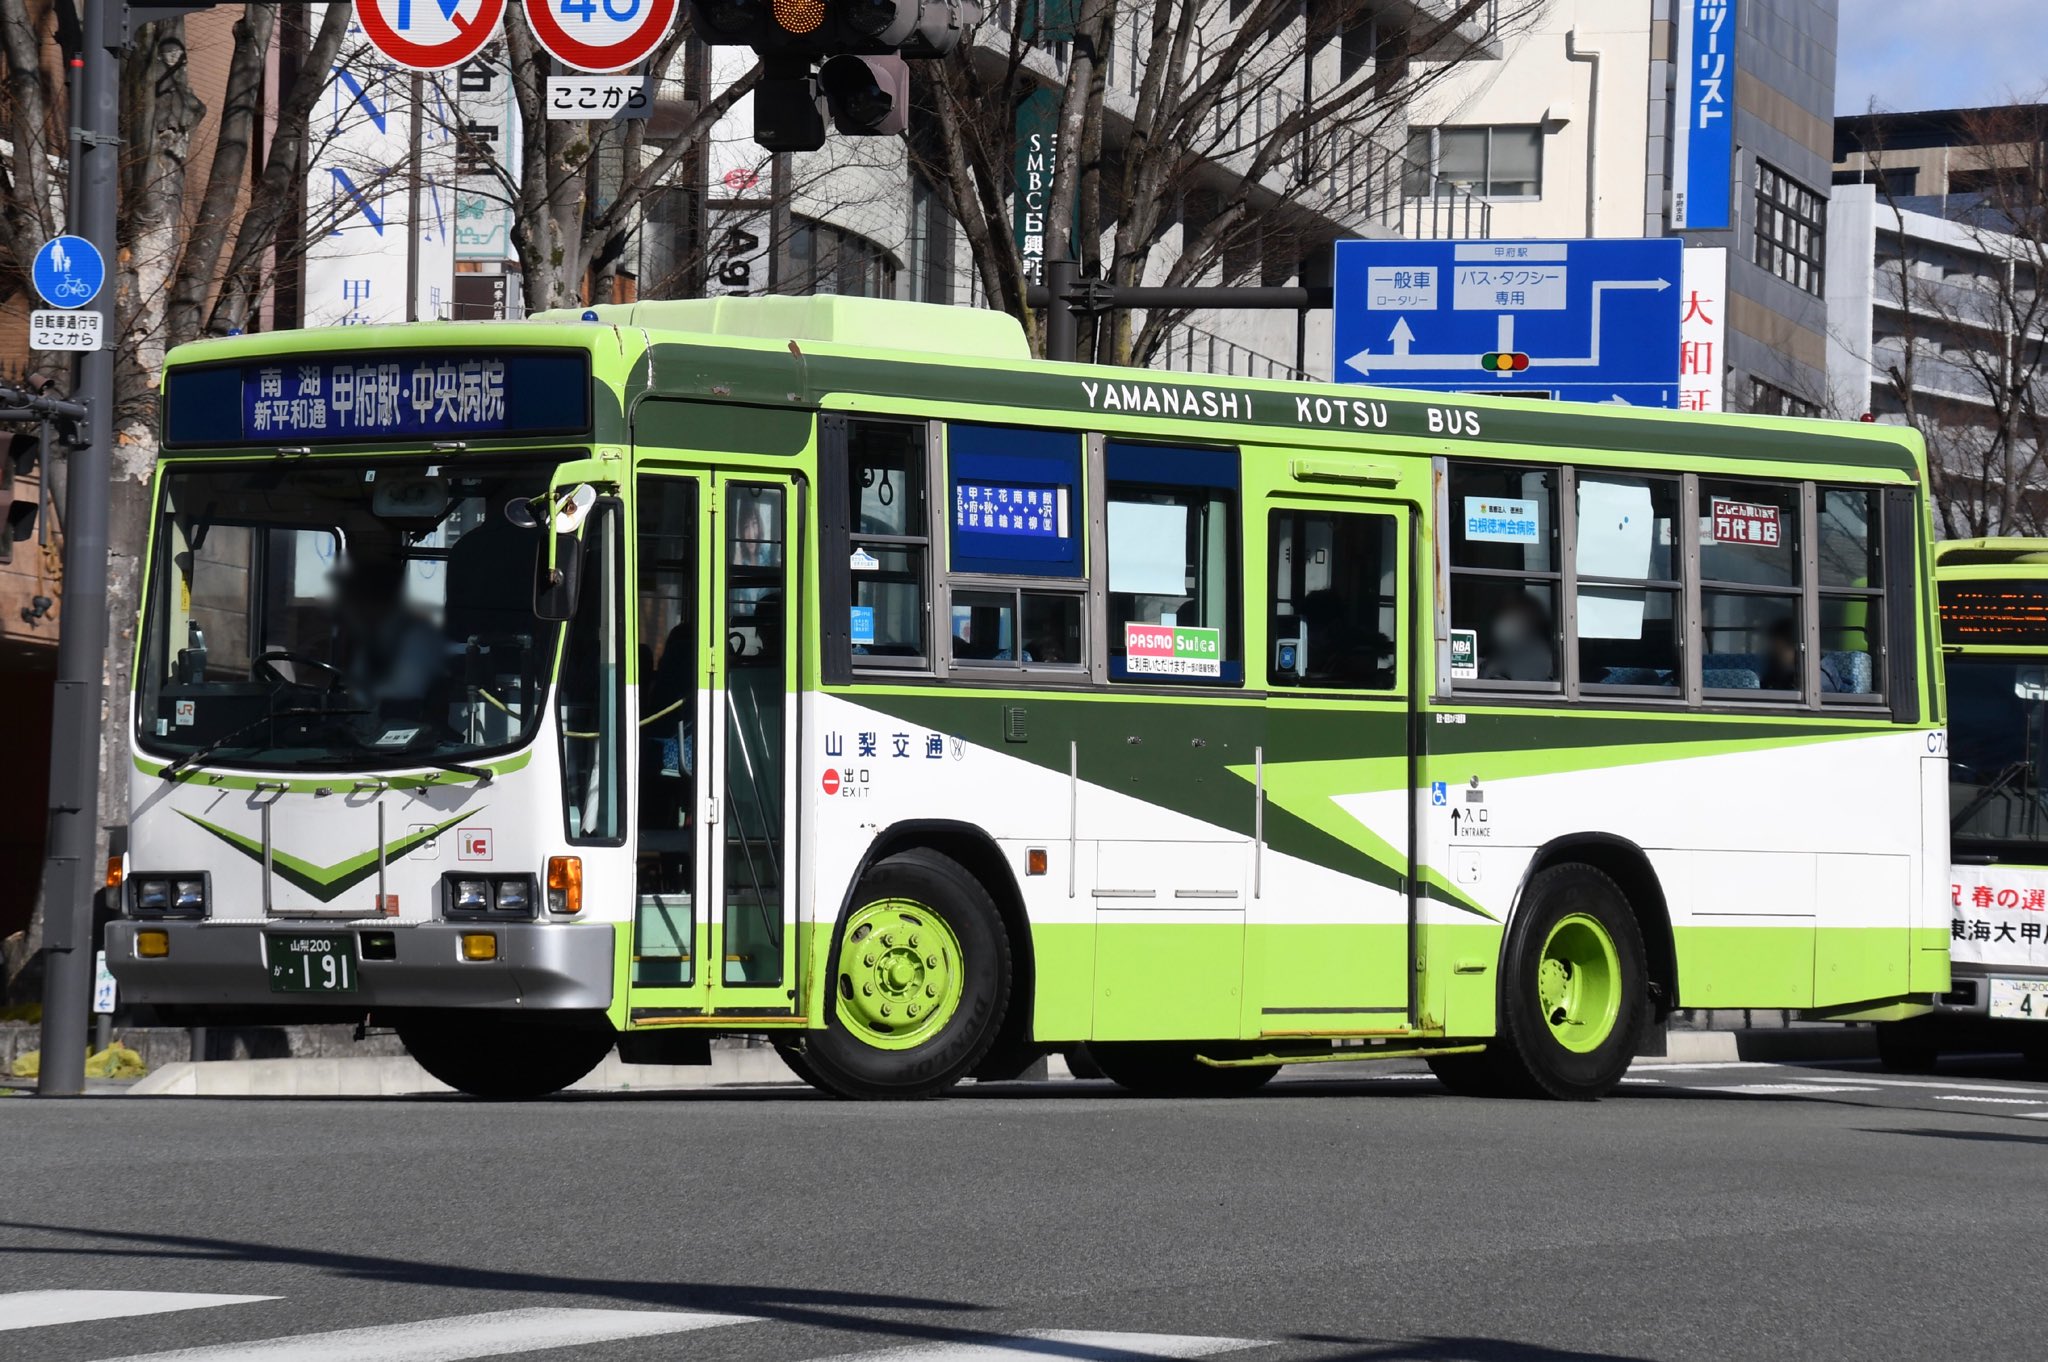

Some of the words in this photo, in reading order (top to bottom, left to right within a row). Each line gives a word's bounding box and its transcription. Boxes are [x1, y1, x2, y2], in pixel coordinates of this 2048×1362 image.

[1699, 0, 1728, 129] ツーリスト
[554, 87, 648, 109] ここから
[1494, 247, 1528, 258] 甲府駅
[719, 227, 759, 297] Ag
[1374, 272, 1431, 290] 一般車
[1461, 271, 1559, 286] バス・タクシー
[1377, 296, 1428, 306] ロータリー
[1495, 291, 1526, 306] 専用
[35, 315, 99, 330] 自転車通行可
[38, 332, 94, 346] ここから
[331, 358, 506, 428] 甲府駅・中央病院
[253, 398, 327, 431] 新平和通
[1081, 381, 1253, 420] YAMANASHI
[1296, 396, 1388, 428] KOTSU
[1427, 407, 1481, 436] BUS
[1468, 517, 1536, 536] 白根徳洲会病院
[1716, 517, 1777, 542] 万代書店
[1129, 633, 1173, 650] PASMO
[1176, 635, 1216, 653] Suica
[1453, 640, 1471, 653] NBA
[177, 703, 193, 716] JR
[825, 731, 944, 759] 山梨交通
[843, 768, 870, 783] 出口
[842, 787, 870, 798] EXIT
[1464, 808, 1488, 823] 入口
[1461, 827, 1490, 837] ENTRANCE
[1951, 918, 2048, 945] 東海大甲
